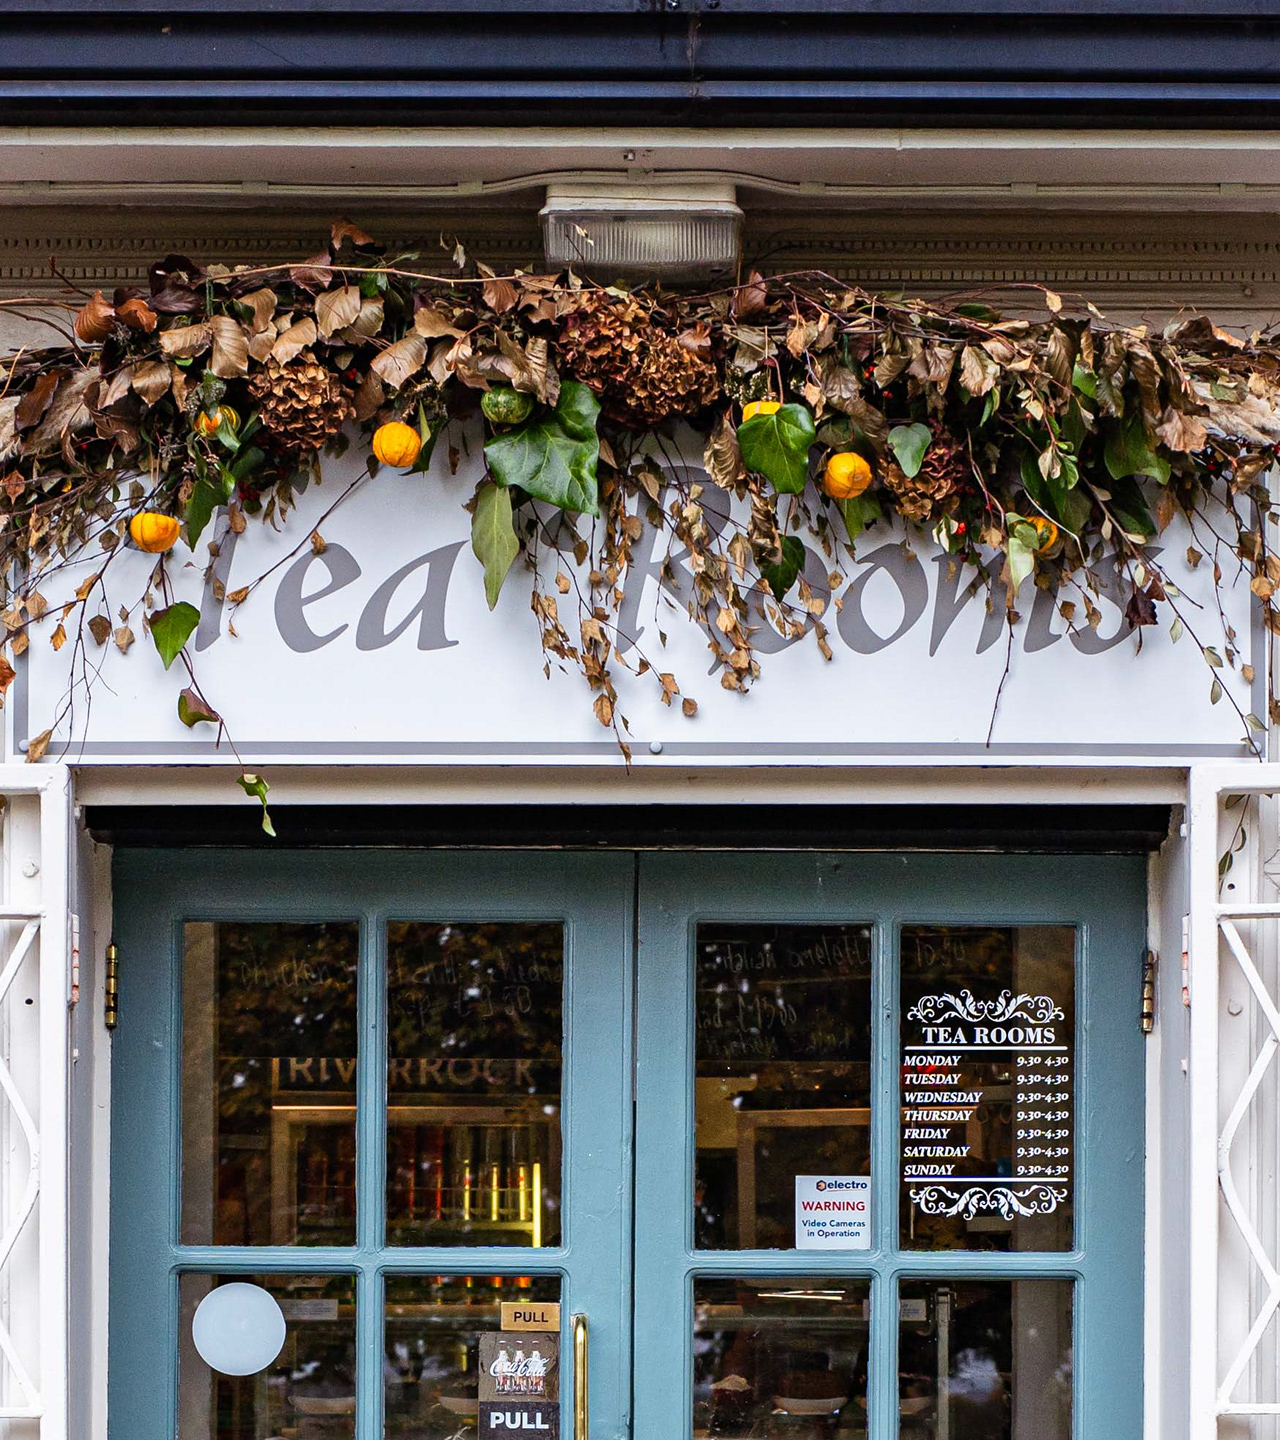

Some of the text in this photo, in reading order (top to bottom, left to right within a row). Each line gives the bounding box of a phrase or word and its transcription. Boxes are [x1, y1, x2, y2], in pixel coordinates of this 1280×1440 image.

[922, 1027, 1056, 1045] TEA ROOMS
[904, 1056, 1069, 1067] MONDAY 9.30 4.30
[289, 1057, 535, 1087] RIVRROCK
[904, 1074, 1069, 1085] TUESDAY 9.30-4.30
[904, 1092, 1069, 1103] WEDNESDAY 9.30-4.30
[904, 1110, 1069, 1121] THURSDAY 9.30-4.30
[904, 1128, 1069, 1139] FRIDAY 9.30-4.30
[904, 1147, 1069, 1158] SATURDAY 9.30-4.30
[904, 1165, 1069, 1176] SUNDAY 9.30-4.30
[827, 1180, 868, 1189] electro
[802, 1201, 866, 1211] WARNING
[802, 1219, 866, 1227] Video Cameras
[807, 1229, 860, 1238] in Operation
[514, 1311, 549, 1323] PULL
[490, 1410, 550, 1430] PULL
